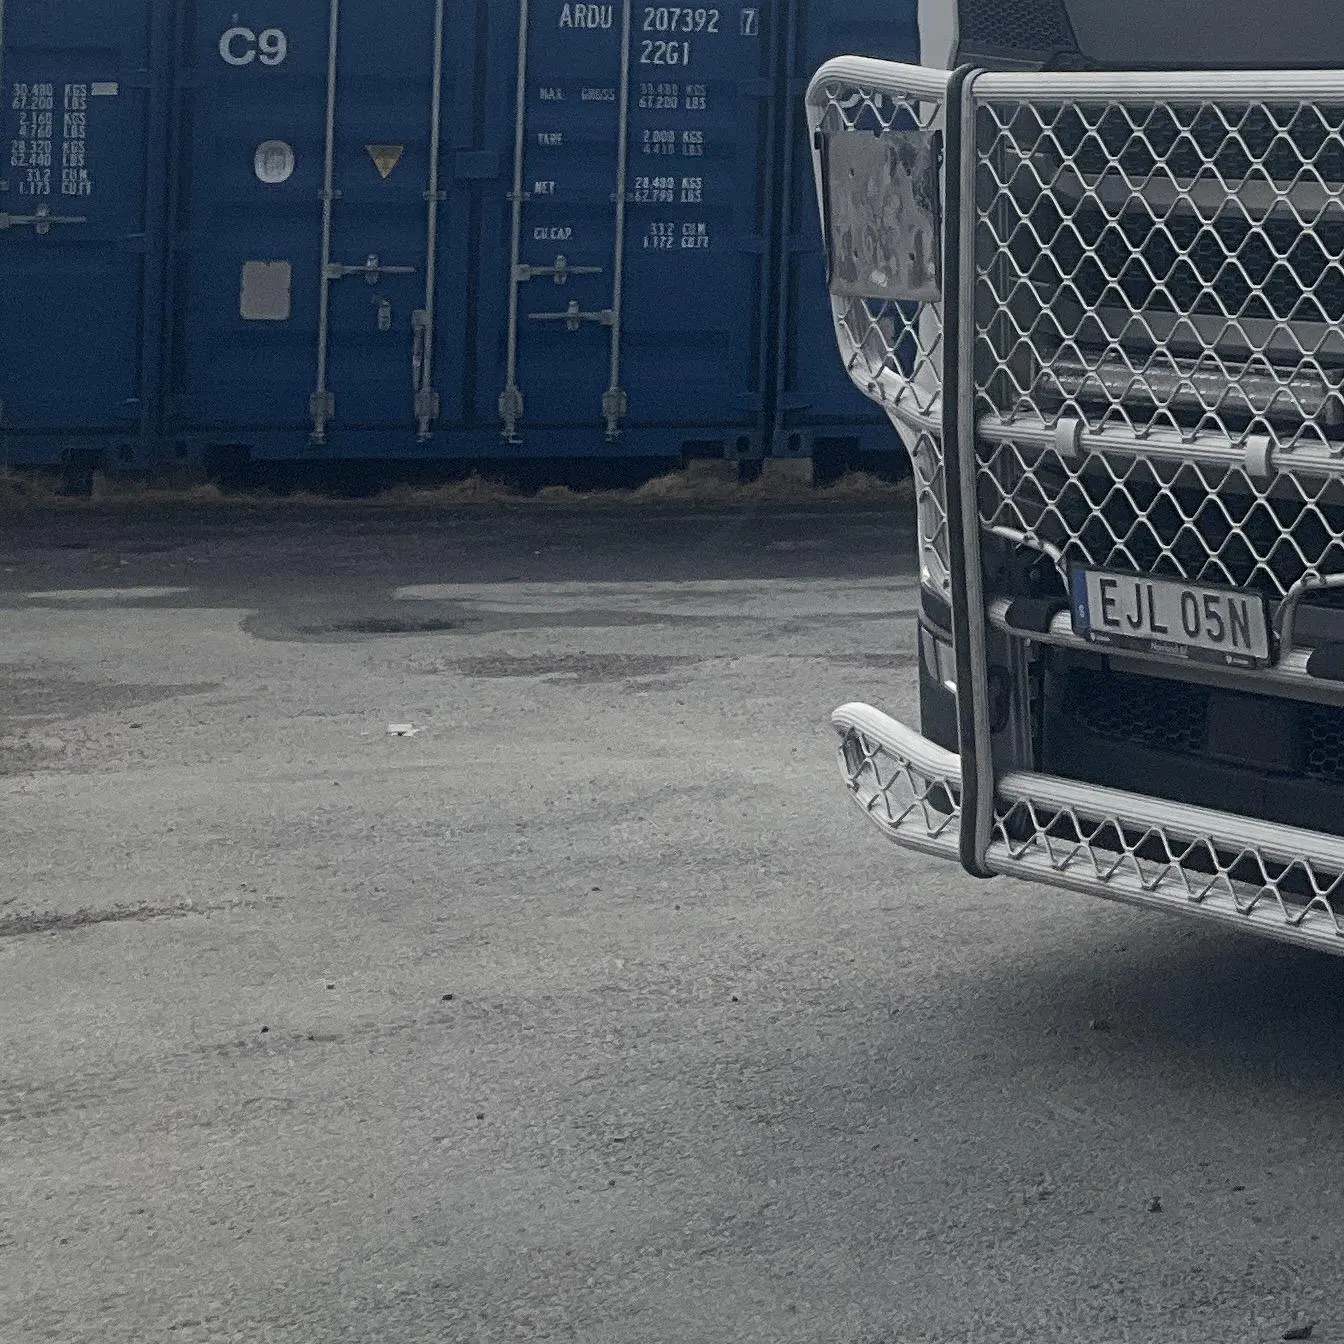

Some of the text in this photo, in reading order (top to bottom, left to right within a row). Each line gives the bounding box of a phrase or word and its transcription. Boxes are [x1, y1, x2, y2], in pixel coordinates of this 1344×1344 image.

[559, 3, 757, 34] ARDU 207392 7
[219, 27, 287, 66] C9
[639, 40, 690, 66] 22G1
[1100, 578, 1252, 649] EJL 05N
